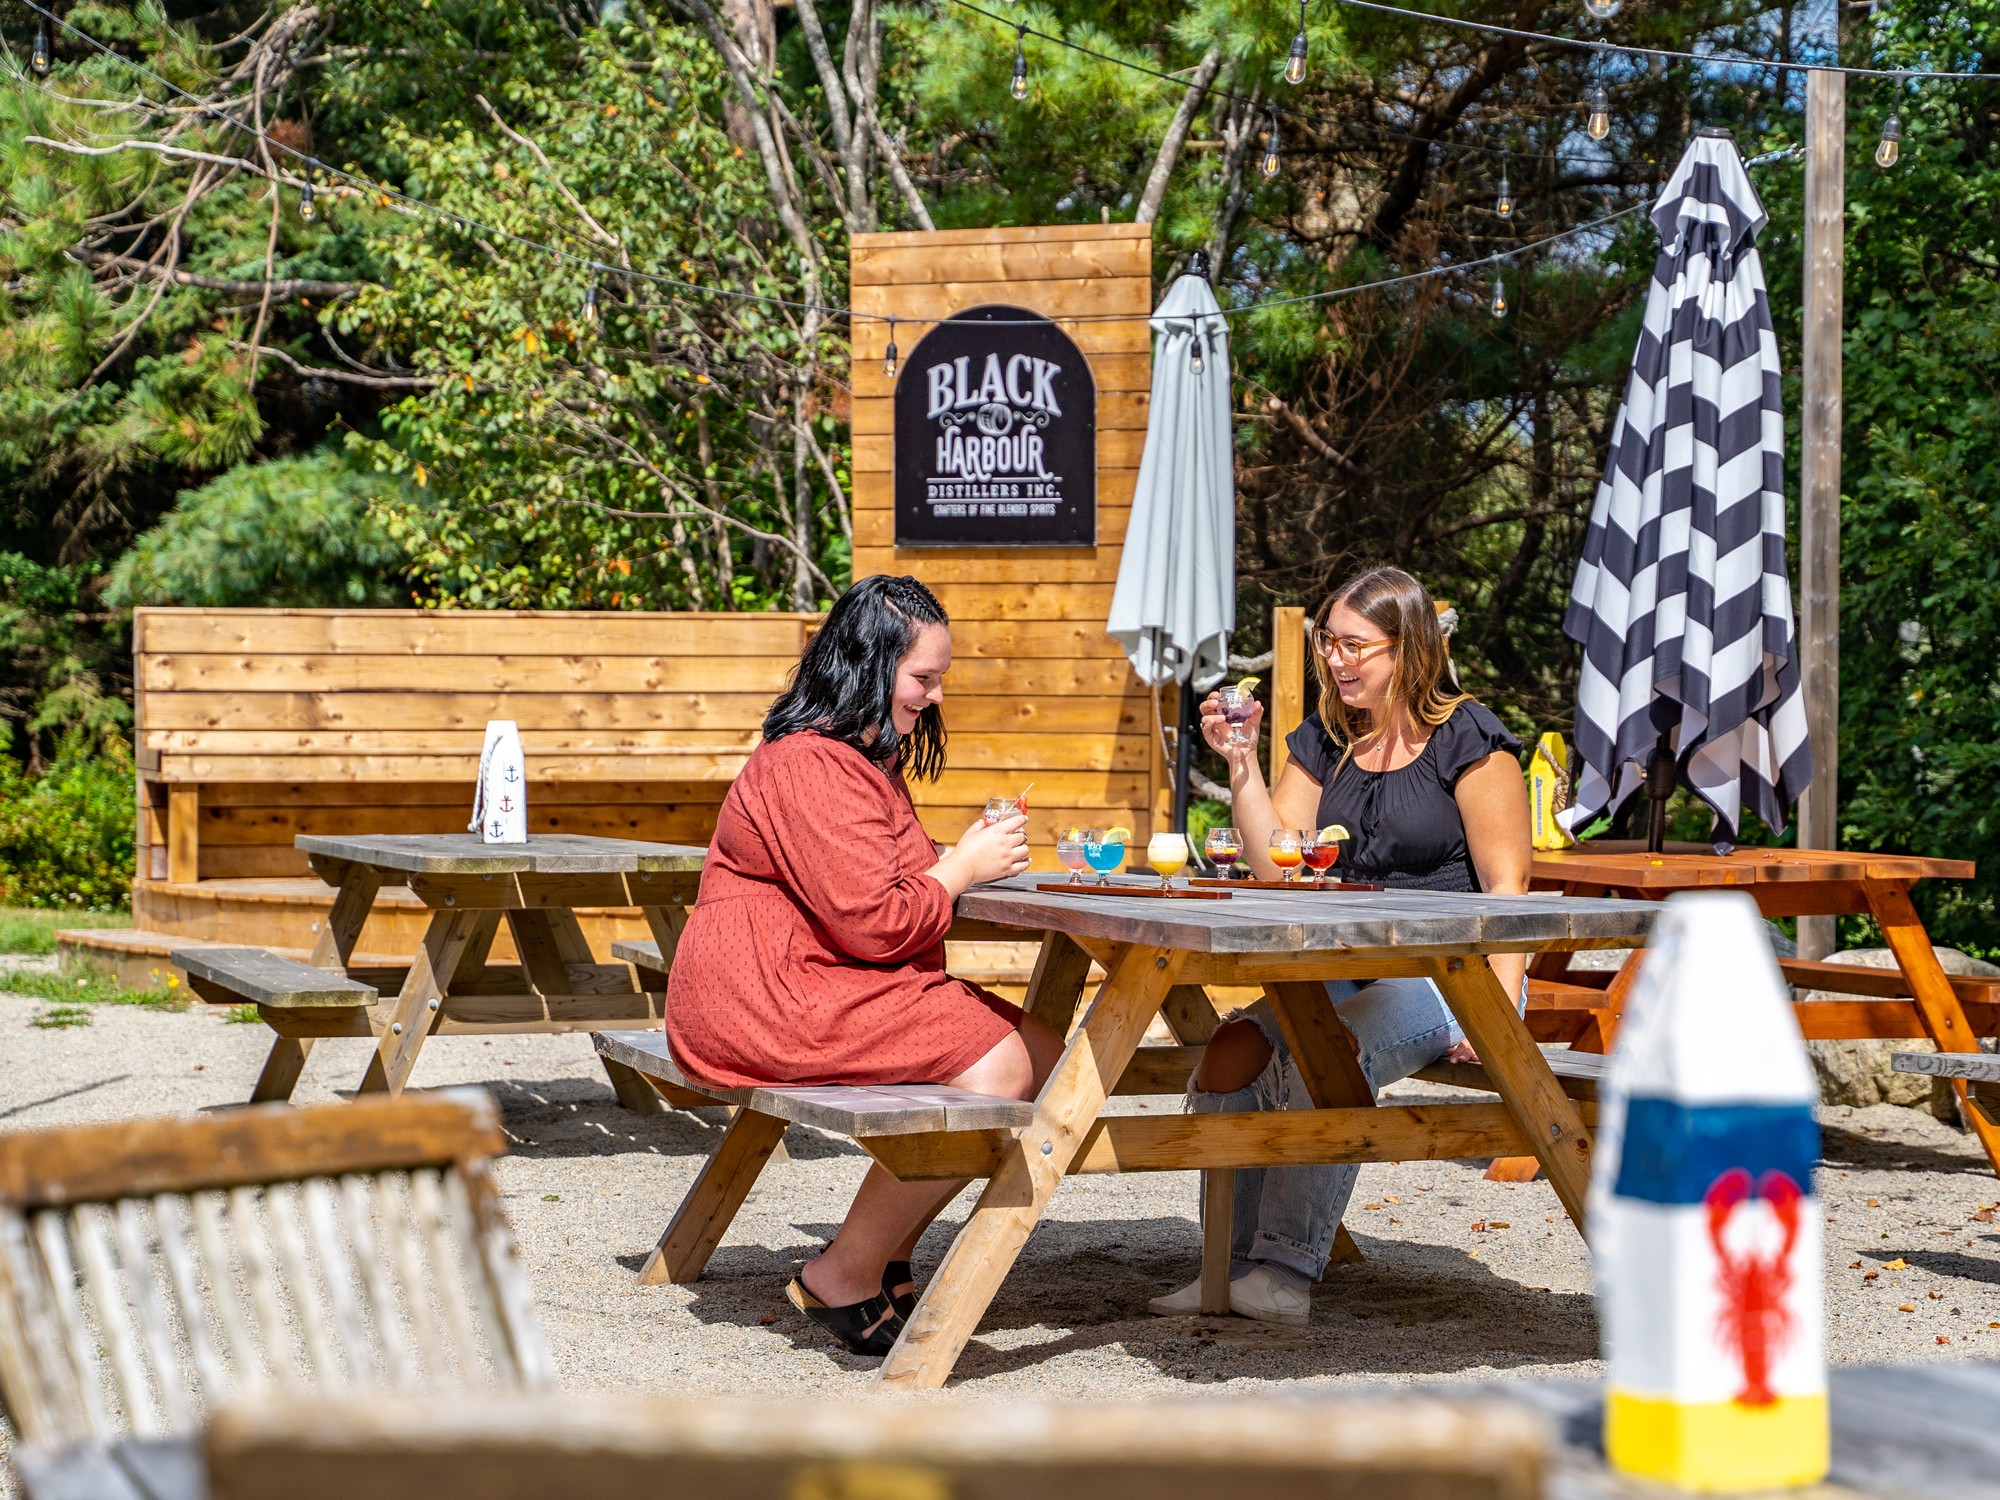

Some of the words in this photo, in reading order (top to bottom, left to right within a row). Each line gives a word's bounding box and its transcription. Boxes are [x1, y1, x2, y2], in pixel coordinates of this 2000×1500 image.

[926, 352, 1063, 420] BLACK
[935, 424, 1055, 483] HARBOUR
[927, 484, 1020, 498] DISTILLERS
[1026, 484, 1061, 498] INC.
[933, 504, 967, 517] CRAFTERS
[968, 504, 979, 517] OF
[980, 504, 996, 517] FINE
[997, 504, 1028, 517] BLENDED
[1029, 503, 1056, 517] SPIRITS
